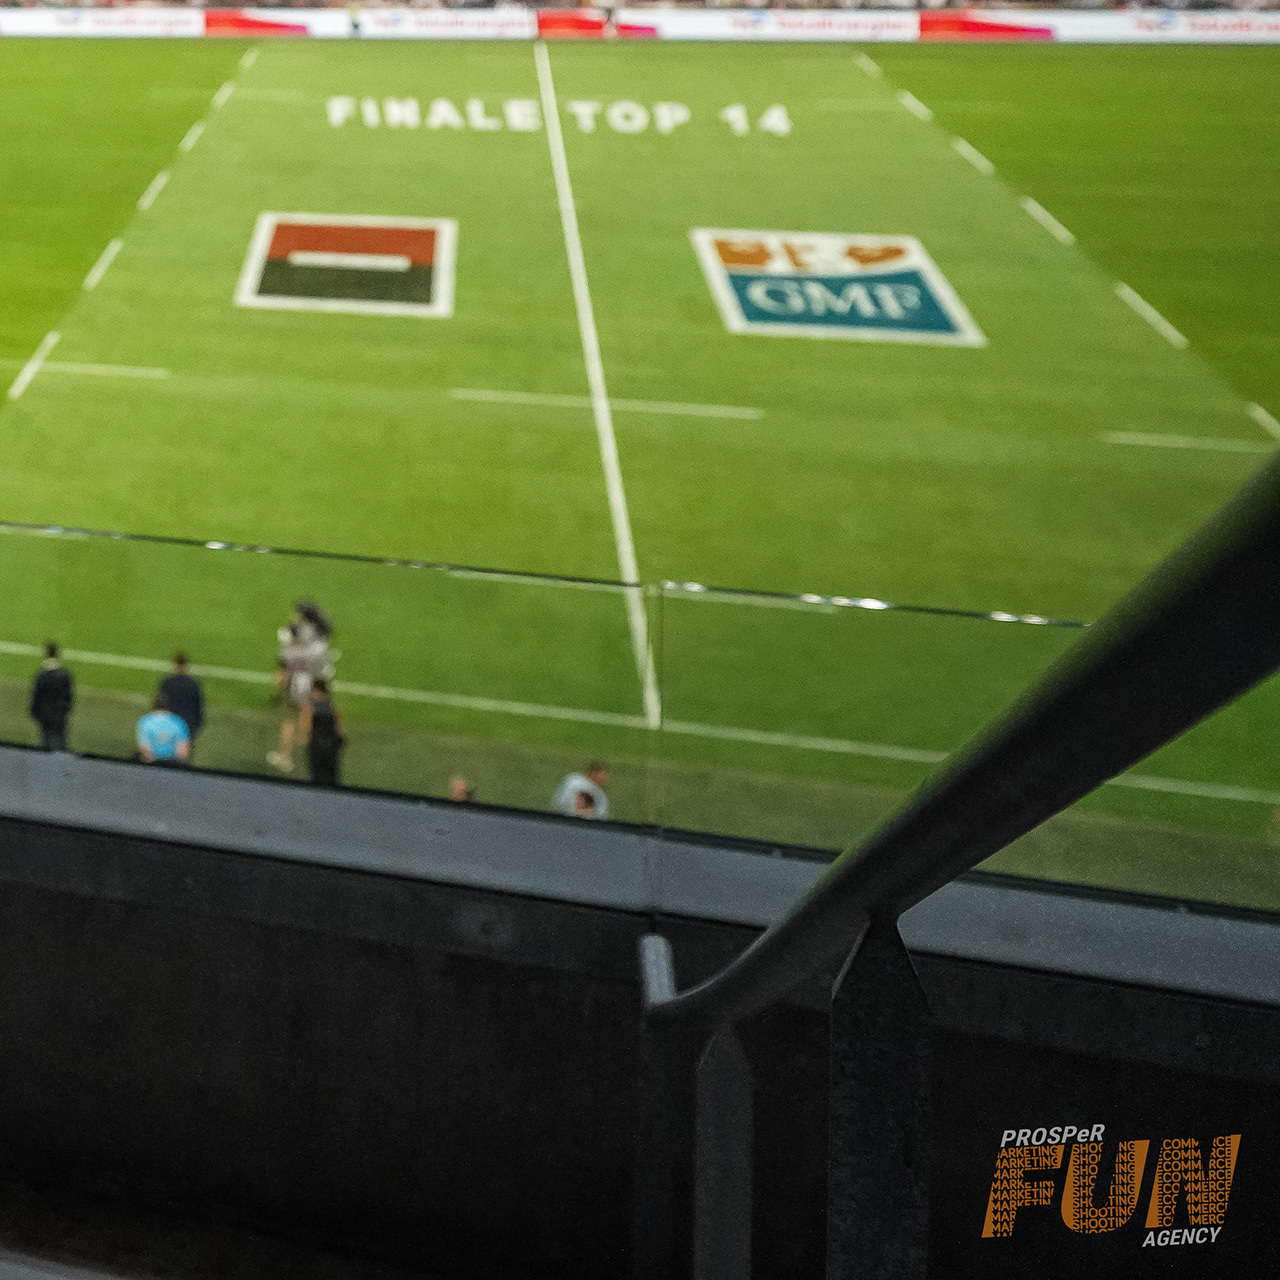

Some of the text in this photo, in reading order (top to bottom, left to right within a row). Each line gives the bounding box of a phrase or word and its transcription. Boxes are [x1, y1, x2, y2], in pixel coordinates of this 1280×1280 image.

[326, 96, 792, 136] FINALE TOP 14
